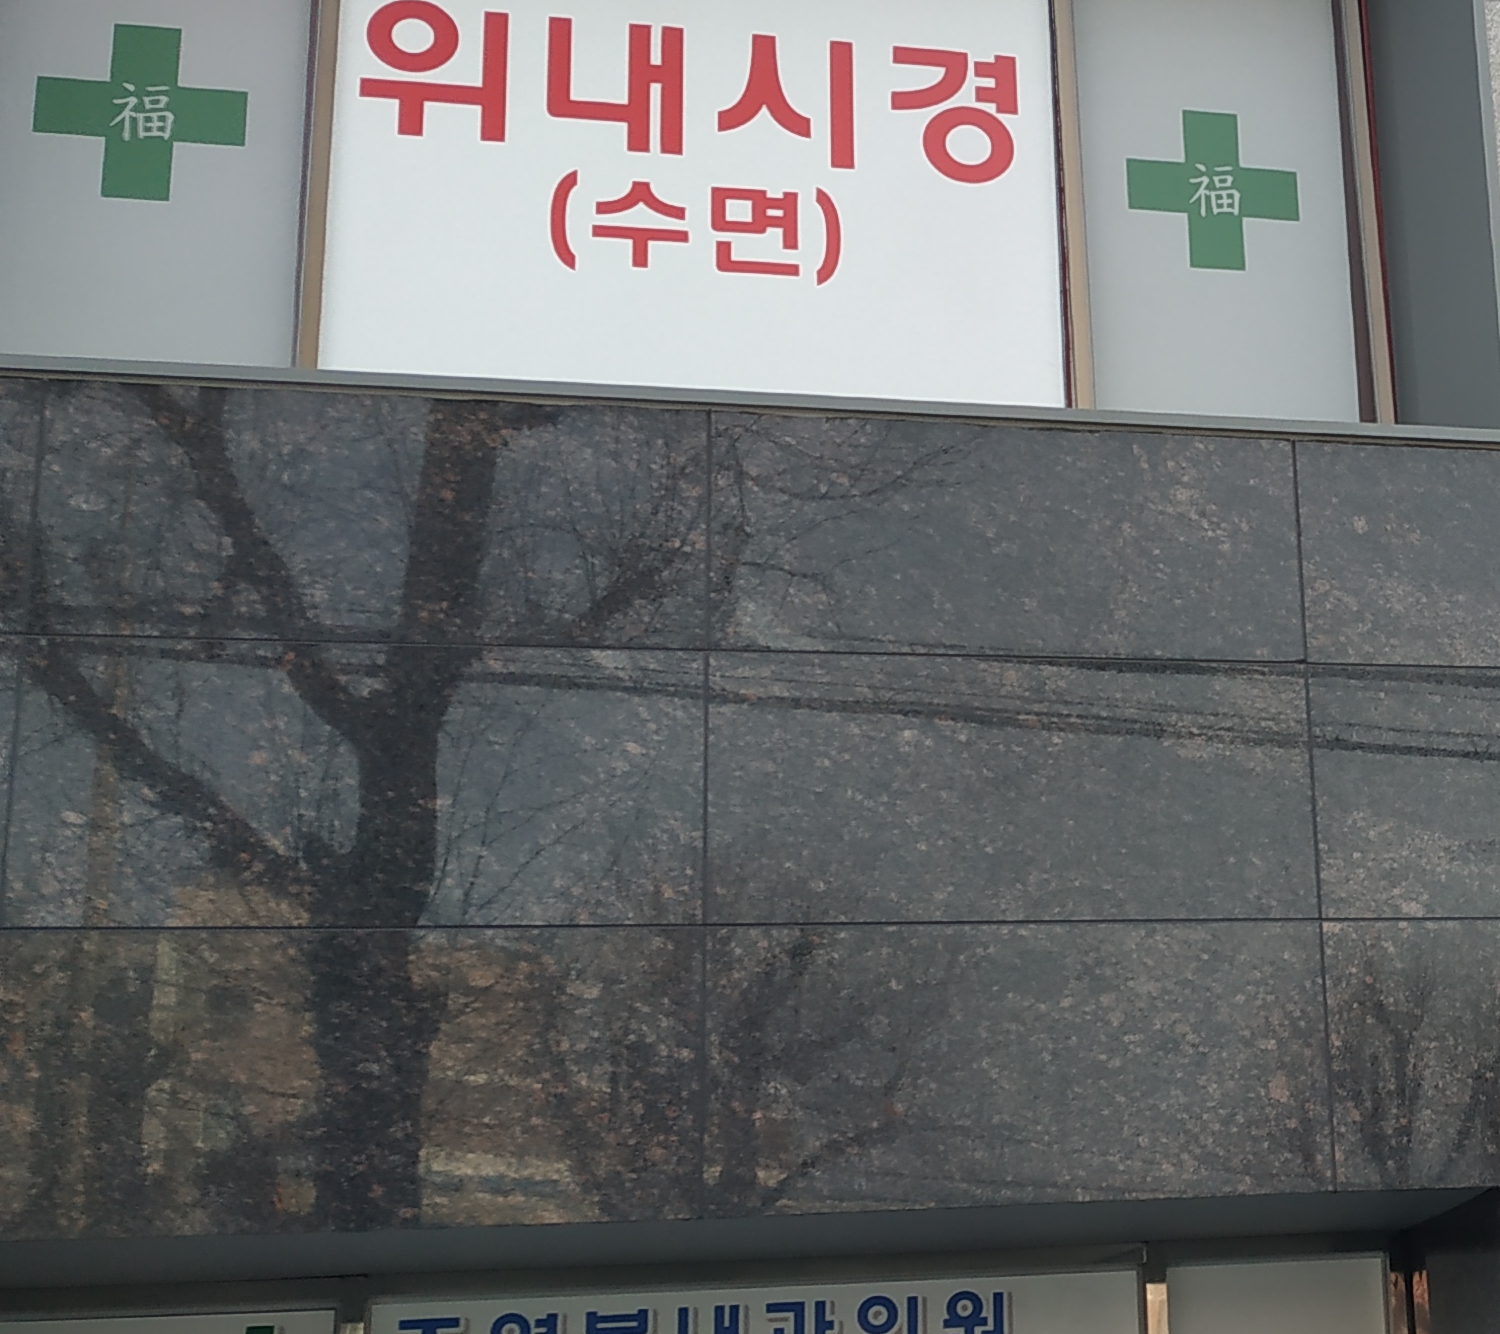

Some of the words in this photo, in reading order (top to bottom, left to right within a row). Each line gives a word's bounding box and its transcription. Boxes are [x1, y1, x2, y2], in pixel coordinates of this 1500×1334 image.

[109, 82, 176, 144] 福
[1189, 163, 1242, 217] 福
[549, 169, 843, 285] (수면)
